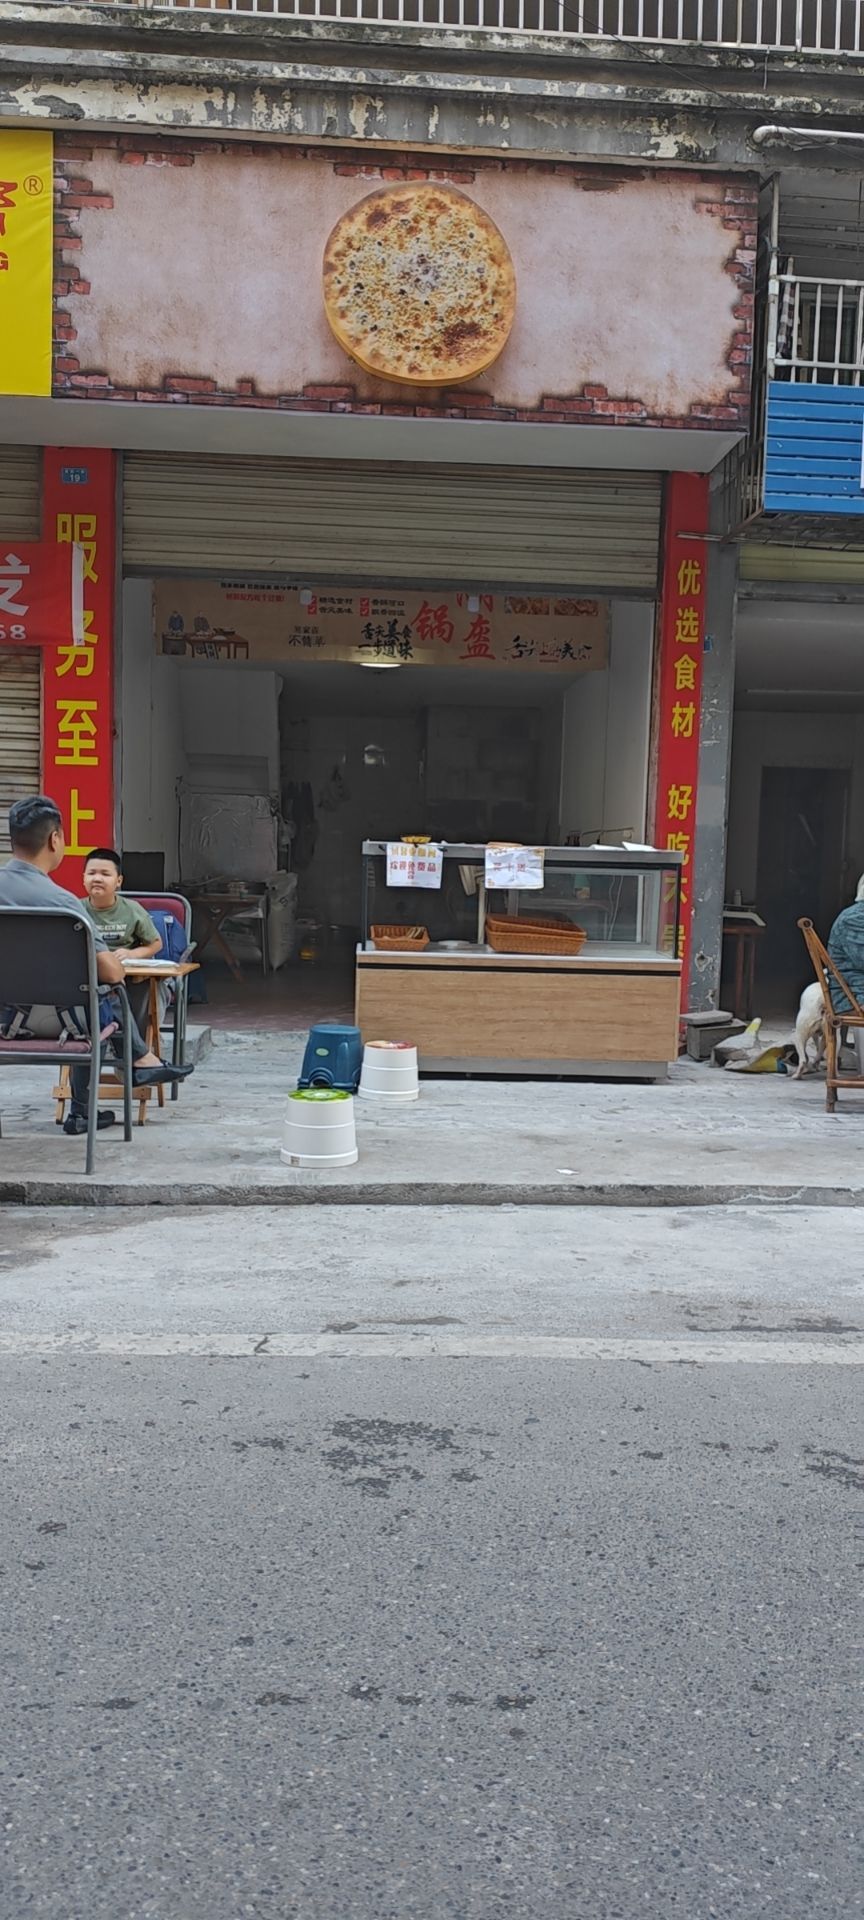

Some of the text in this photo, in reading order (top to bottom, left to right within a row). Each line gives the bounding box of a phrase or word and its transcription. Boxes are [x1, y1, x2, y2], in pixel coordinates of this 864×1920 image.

[70, 474, 81, 482] 19
[671, 559, 701, 739] 优选食材
